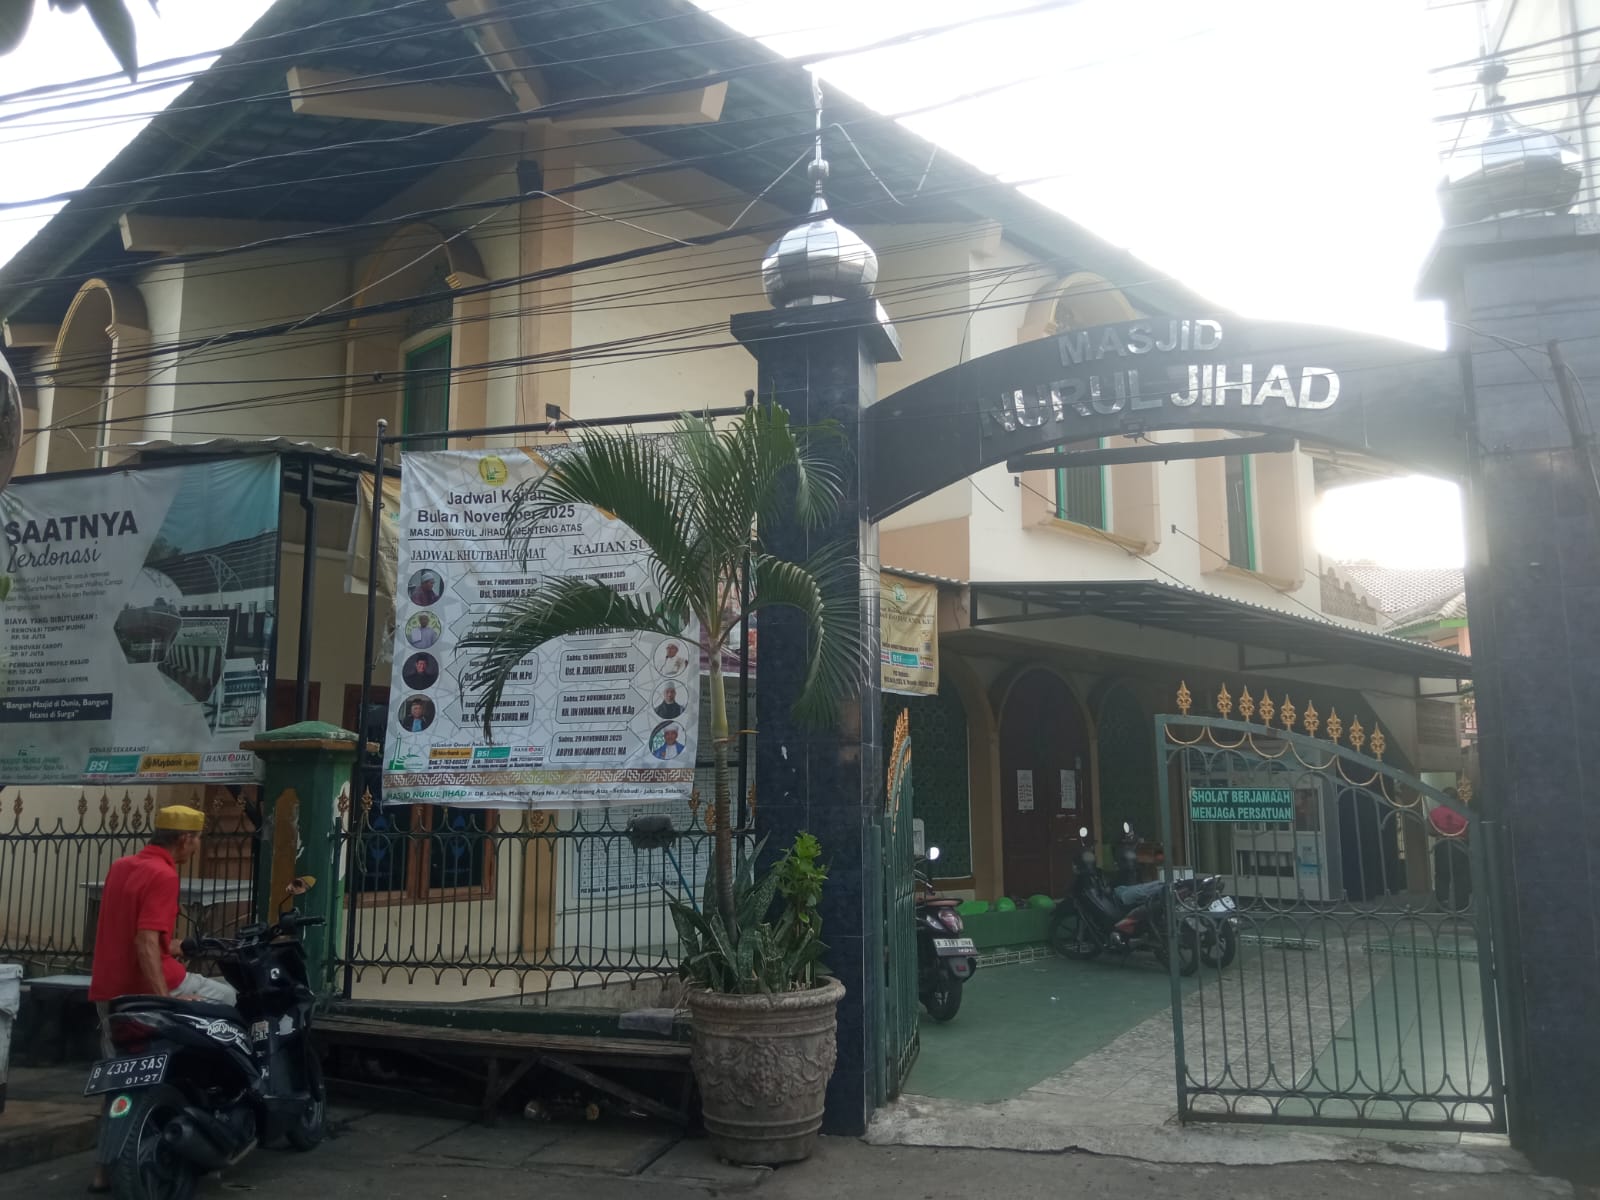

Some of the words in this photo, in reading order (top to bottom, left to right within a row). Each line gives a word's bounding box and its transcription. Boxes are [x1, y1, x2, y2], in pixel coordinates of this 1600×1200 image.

[1057, 318, 1223, 367] MASJID
[978, 368, 1163, 435] NURUL
[1170, 363, 1341, 410] JIHAD
[447, 491, 497, 505] Jadwal
[418, 509, 459, 523] Bulan
[464, 511, 537, 524] November
[543, 504, 575, 520] 2025
[5, 509, 139, 546] SAATNYA
[409, 529, 444, 537] MASJID
[446, 528, 476, 537] NURUL
[479, 527, 506, 536] JIHAD
[514, 525, 558, 536] MENTENG
[560, 523, 583, 533] ATAS
[410, 549, 455, 561] JADWAL
[457, 549, 508, 561] KHUTBAH
[573, 541, 624, 556] KAJIAN
[6, 539, 103, 574] Berdonasi
[498, 578, 524, 586] NOVEMBER
[4, 617, 28, 625] BIAYA
[30, 616, 49, 624] YANG
[589, 652, 614, 660] NOVEMBER
[82, 697, 109, 708] Bangun
[89, 760, 108, 771] BSI
[151, 757, 184, 769] Maybank
[387, 791, 411, 801] MASJID
[413, 790, 441, 799] NURUL
[442, 789, 467, 799] JIHAD
[1192, 790, 1229, 803] SHOLAT
[1192, 807, 1237, 819] MENJAGA
[1238, 807, 1292, 820] PERSATUAN
[93, 1067, 102, 1079] B
[106, 1060, 138, 1076] 4337
[139, 1056, 164, 1072] SAS
